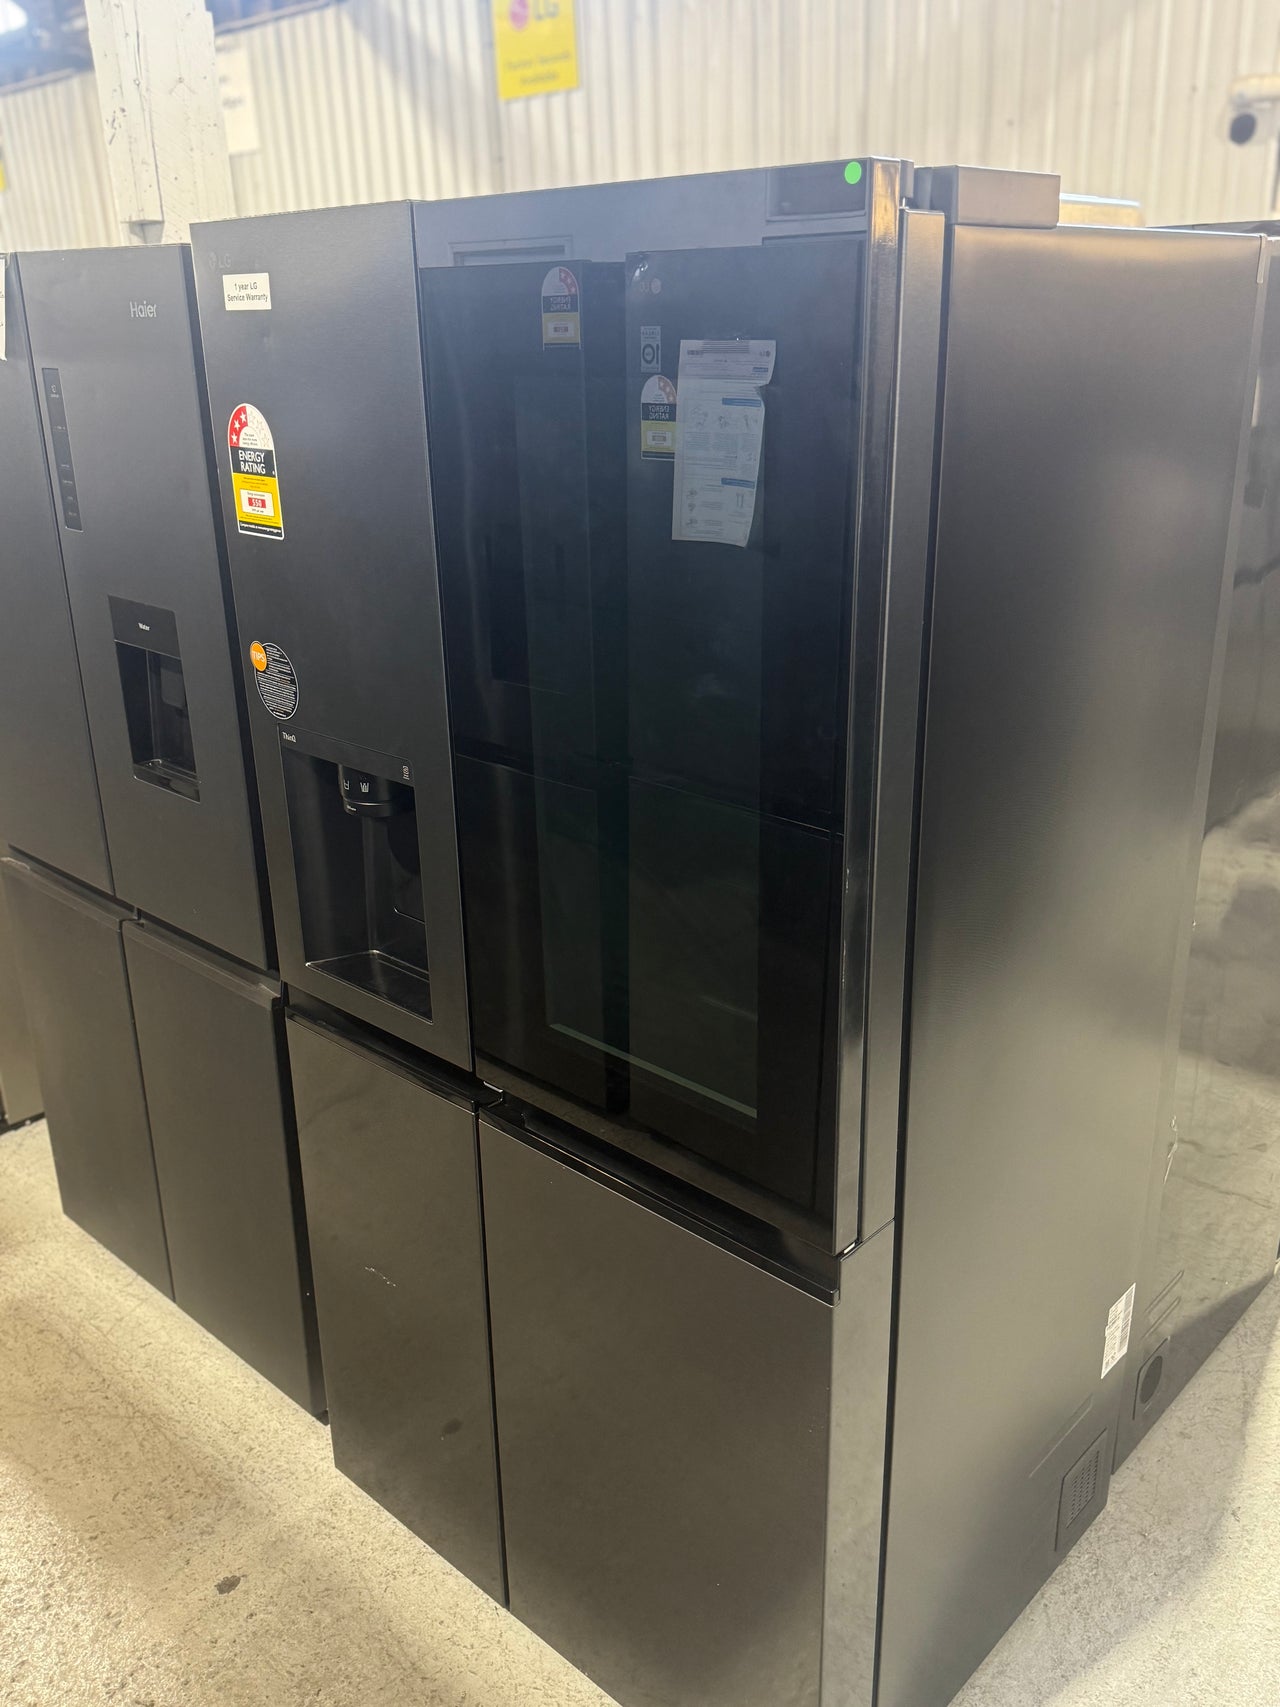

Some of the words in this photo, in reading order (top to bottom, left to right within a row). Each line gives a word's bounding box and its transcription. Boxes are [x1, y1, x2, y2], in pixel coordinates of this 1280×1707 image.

[532, 0, 560, 20] LG
[238, 283, 249, 292] year
[250, 281, 258, 290] LG
[227, 293, 245, 302] Service
[246, 293, 268, 303] Warranty
[129, 300, 157, 318] Haier
[238, 449, 265, 463] ENERGY
[240, 461, 266, 474] RATING
[251, 650, 265, 662] TIPS
[282, 731, 297, 743] ThinQ
